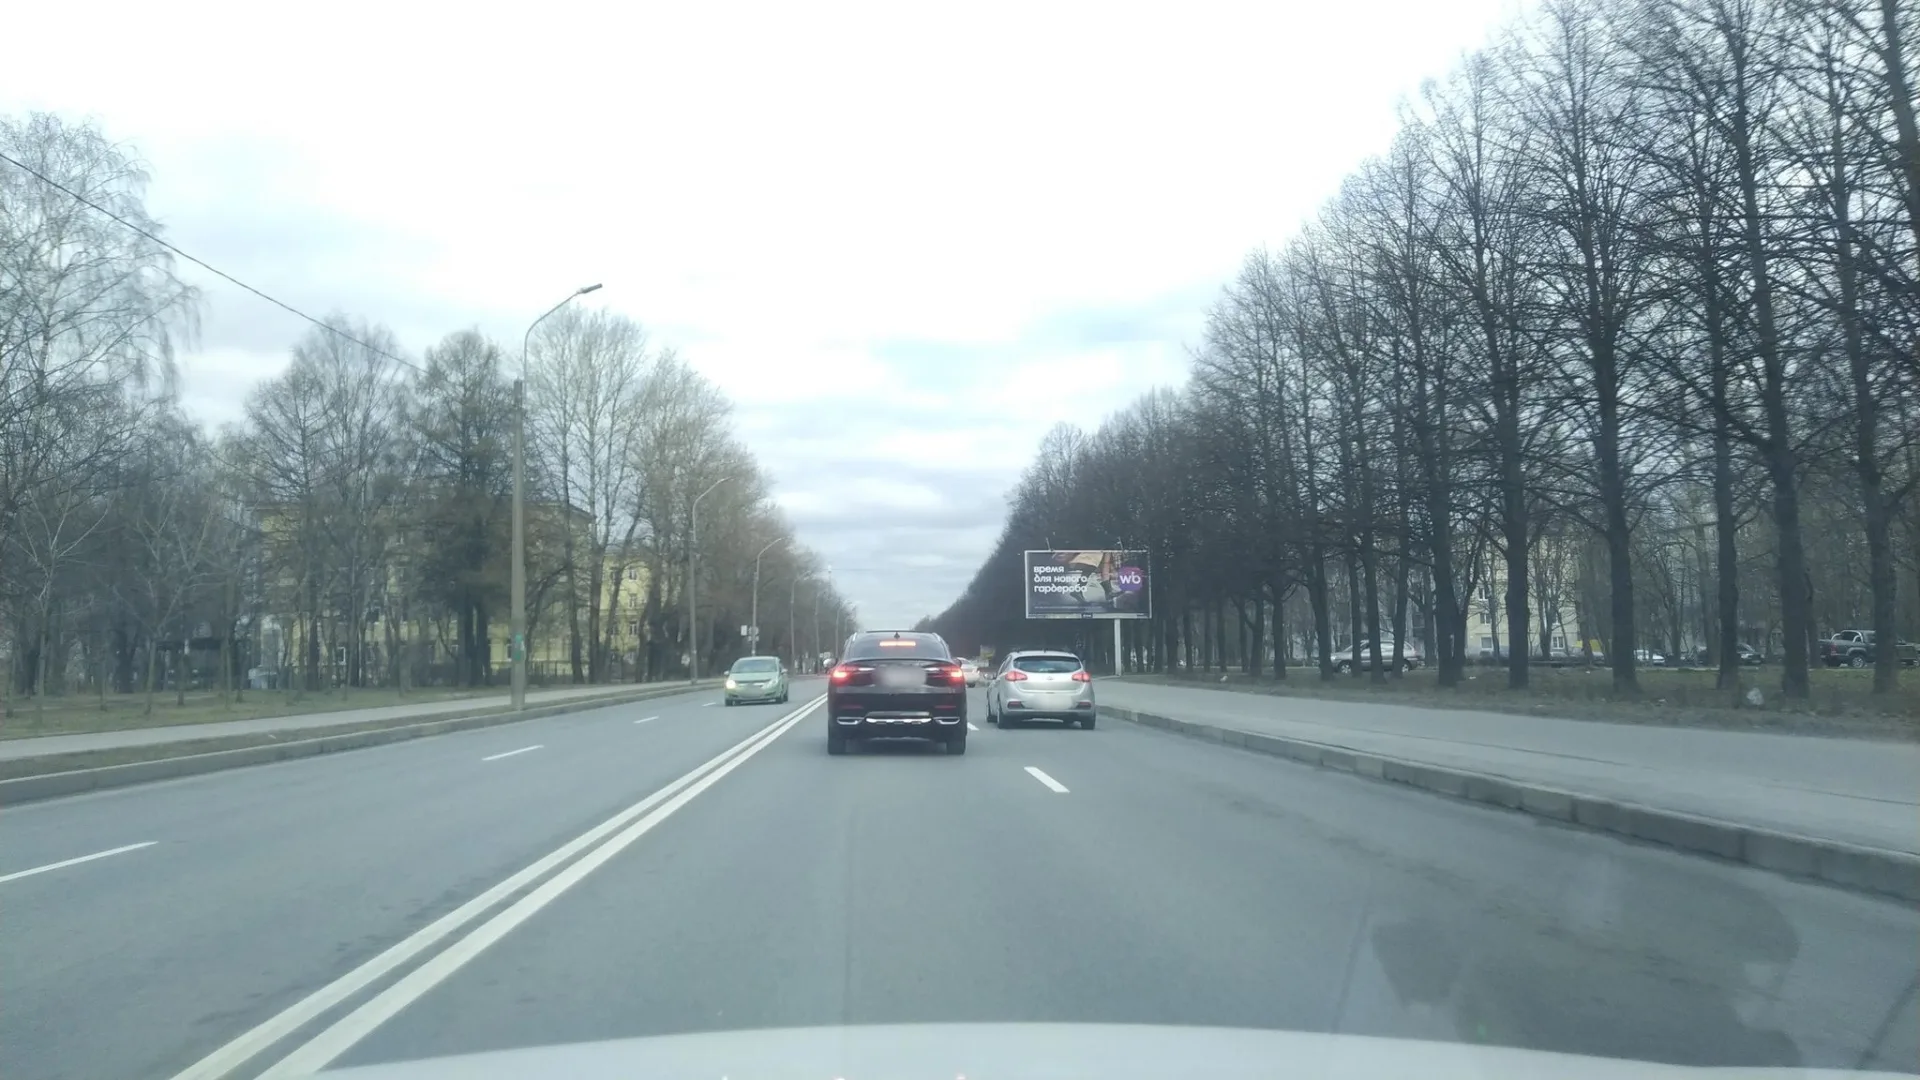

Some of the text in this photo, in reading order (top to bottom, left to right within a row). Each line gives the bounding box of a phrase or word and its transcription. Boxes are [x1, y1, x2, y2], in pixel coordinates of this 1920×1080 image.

[1033, 565, 1064, 575] время
[1033, 574, 1051, 582] для
[1120, 571, 1141, 584] wb
[1034, 583, 1087, 594] гардероба
